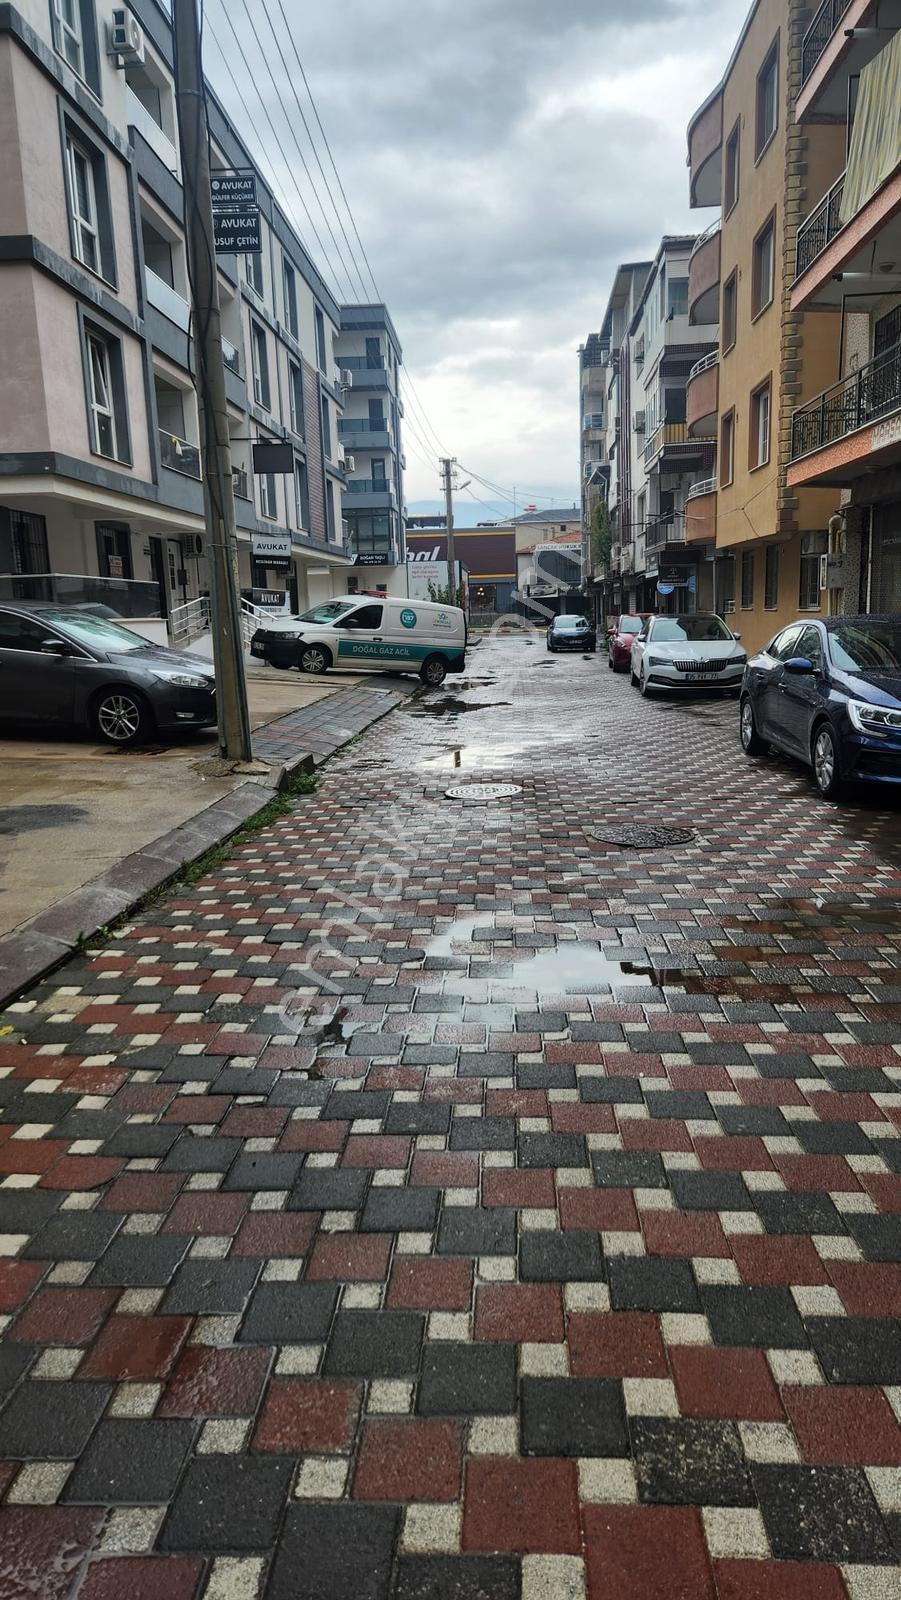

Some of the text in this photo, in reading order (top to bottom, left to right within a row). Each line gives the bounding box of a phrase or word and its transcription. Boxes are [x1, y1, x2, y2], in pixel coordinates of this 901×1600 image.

[221, 181, 252, 190] AVUKAT
[221, 218, 257, 228] AVUKAT
[236, 234, 259, 247] ÇETİN
[256, 543, 288, 551] AVUKAT
[261, 593, 280, 603] AVUKAT
[352, 645, 379, 654] DOĞAL
[394, 648, 411, 656] ACİL
